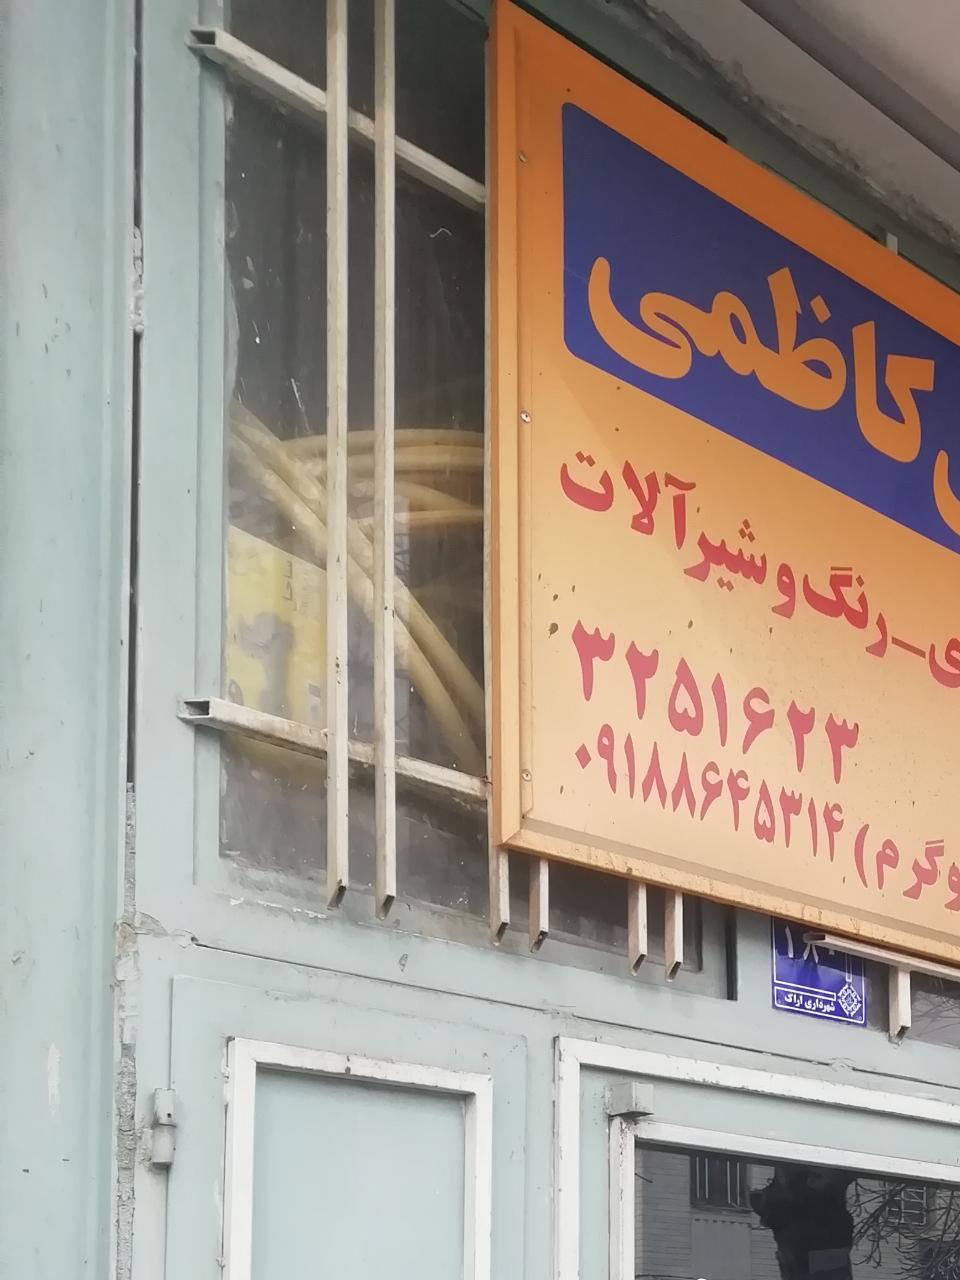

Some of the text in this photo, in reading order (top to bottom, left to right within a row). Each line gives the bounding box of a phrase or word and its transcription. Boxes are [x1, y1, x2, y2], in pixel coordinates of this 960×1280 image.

[588, 255, 934, 463] کاظمی
[771, 562, 797, 619] و
[802, 565, 888, 658] رنگ
[571, 619, 859, 785] ۳۲۵۱۶۲۳
[575, 723, 845, 863] ۰۹۱۸۸۶۴۵۳۱۴
[784, 994, 836, 1013] شهرداری اراک
